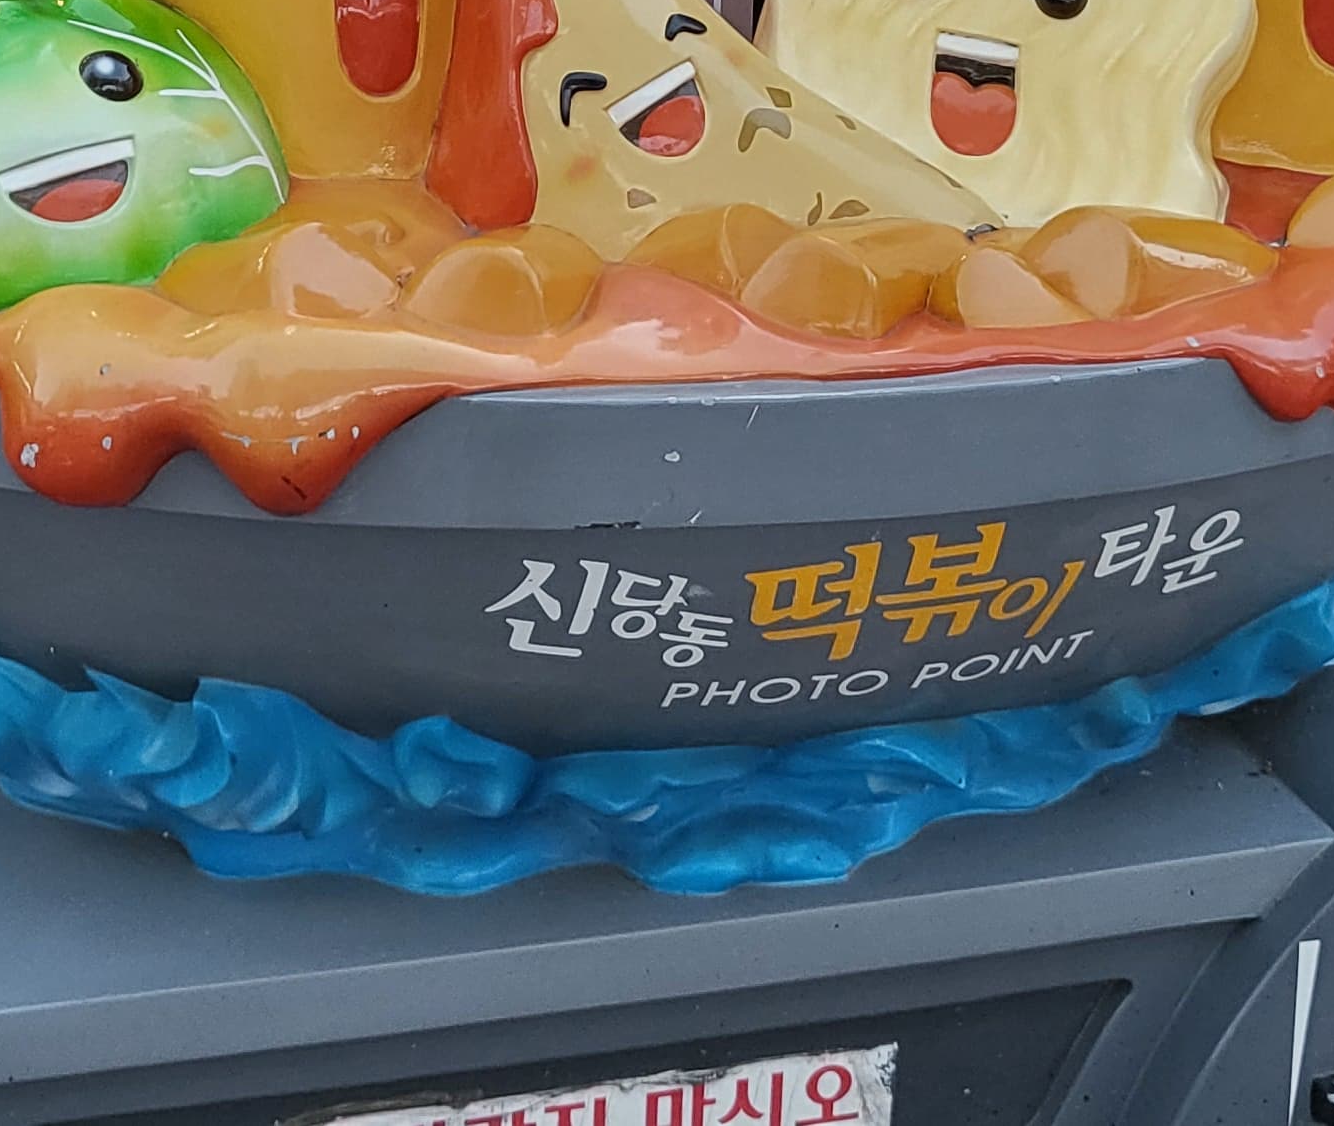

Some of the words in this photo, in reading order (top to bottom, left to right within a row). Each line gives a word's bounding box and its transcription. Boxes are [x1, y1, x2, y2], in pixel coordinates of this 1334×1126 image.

[484, 558, 736, 670] 신당동
[743, 522, 1086, 662] 떡볶이
[1094, 505, 1245, 595] 타운
[660, 668, 890, 709] PHOTO
[909, 630, 1095, 690] POINT
[643, 1064, 861, 1126] 마시오
